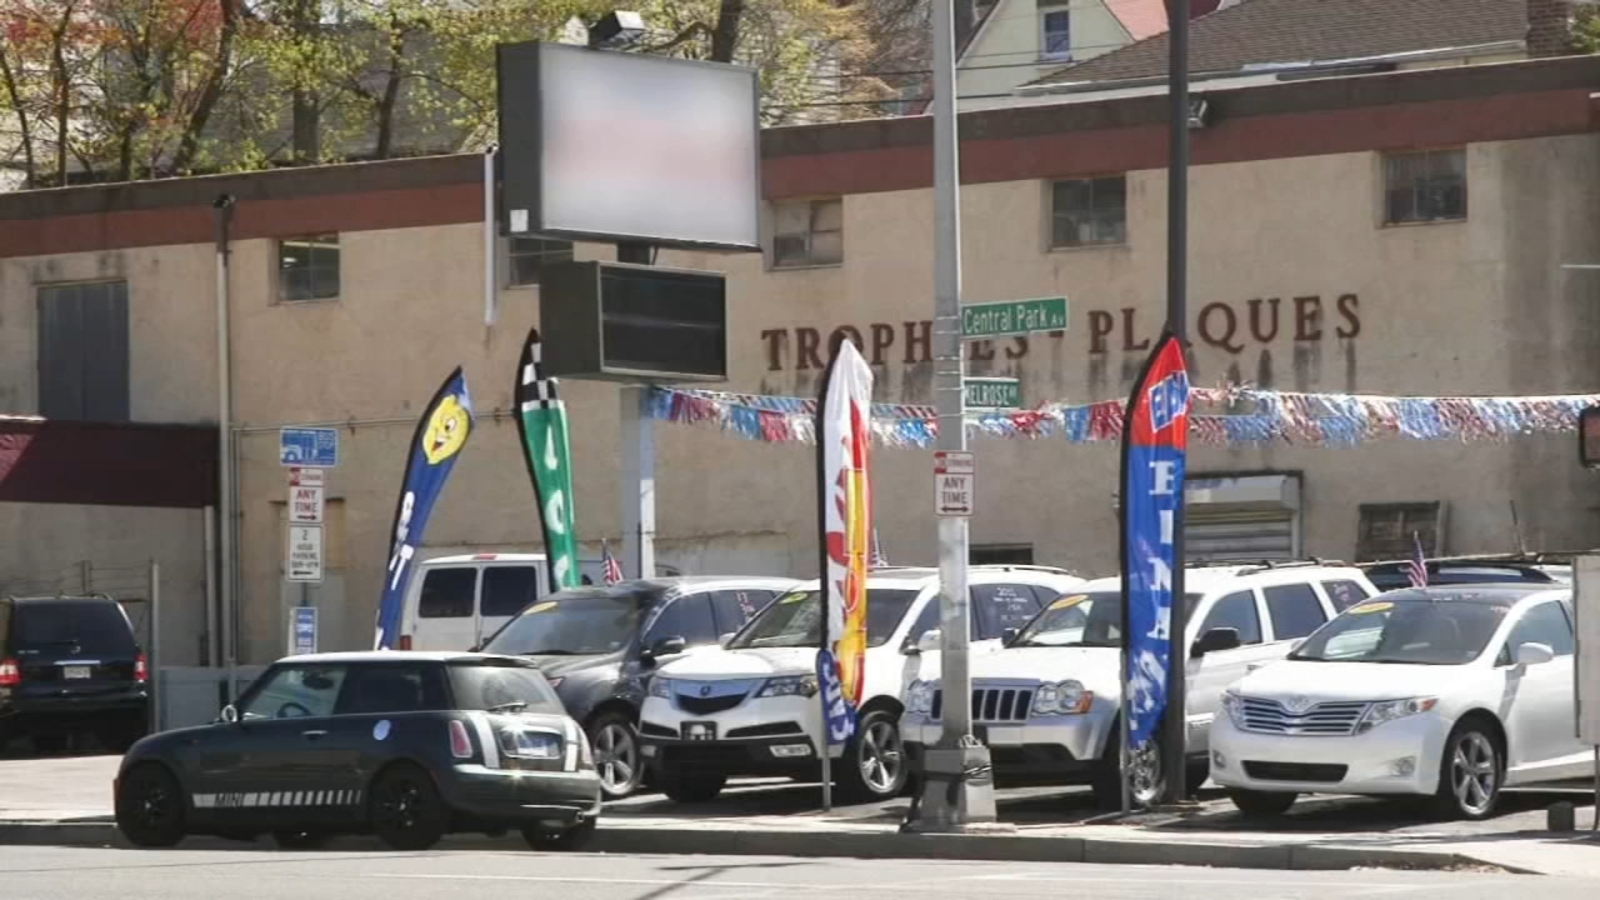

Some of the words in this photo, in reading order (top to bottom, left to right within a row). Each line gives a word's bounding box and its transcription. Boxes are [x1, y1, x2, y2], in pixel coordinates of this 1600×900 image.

[964, 305, 1012, 335] Central
[1015, 304, 1047, 330] Park
[1088, 294, 1361, 354] PLQUES
[943, 477, 966, 489] ANY
[296, 489, 316, 500] ANY
[942, 491, 968, 504] TIME
[294, 501, 318, 513] TIME
